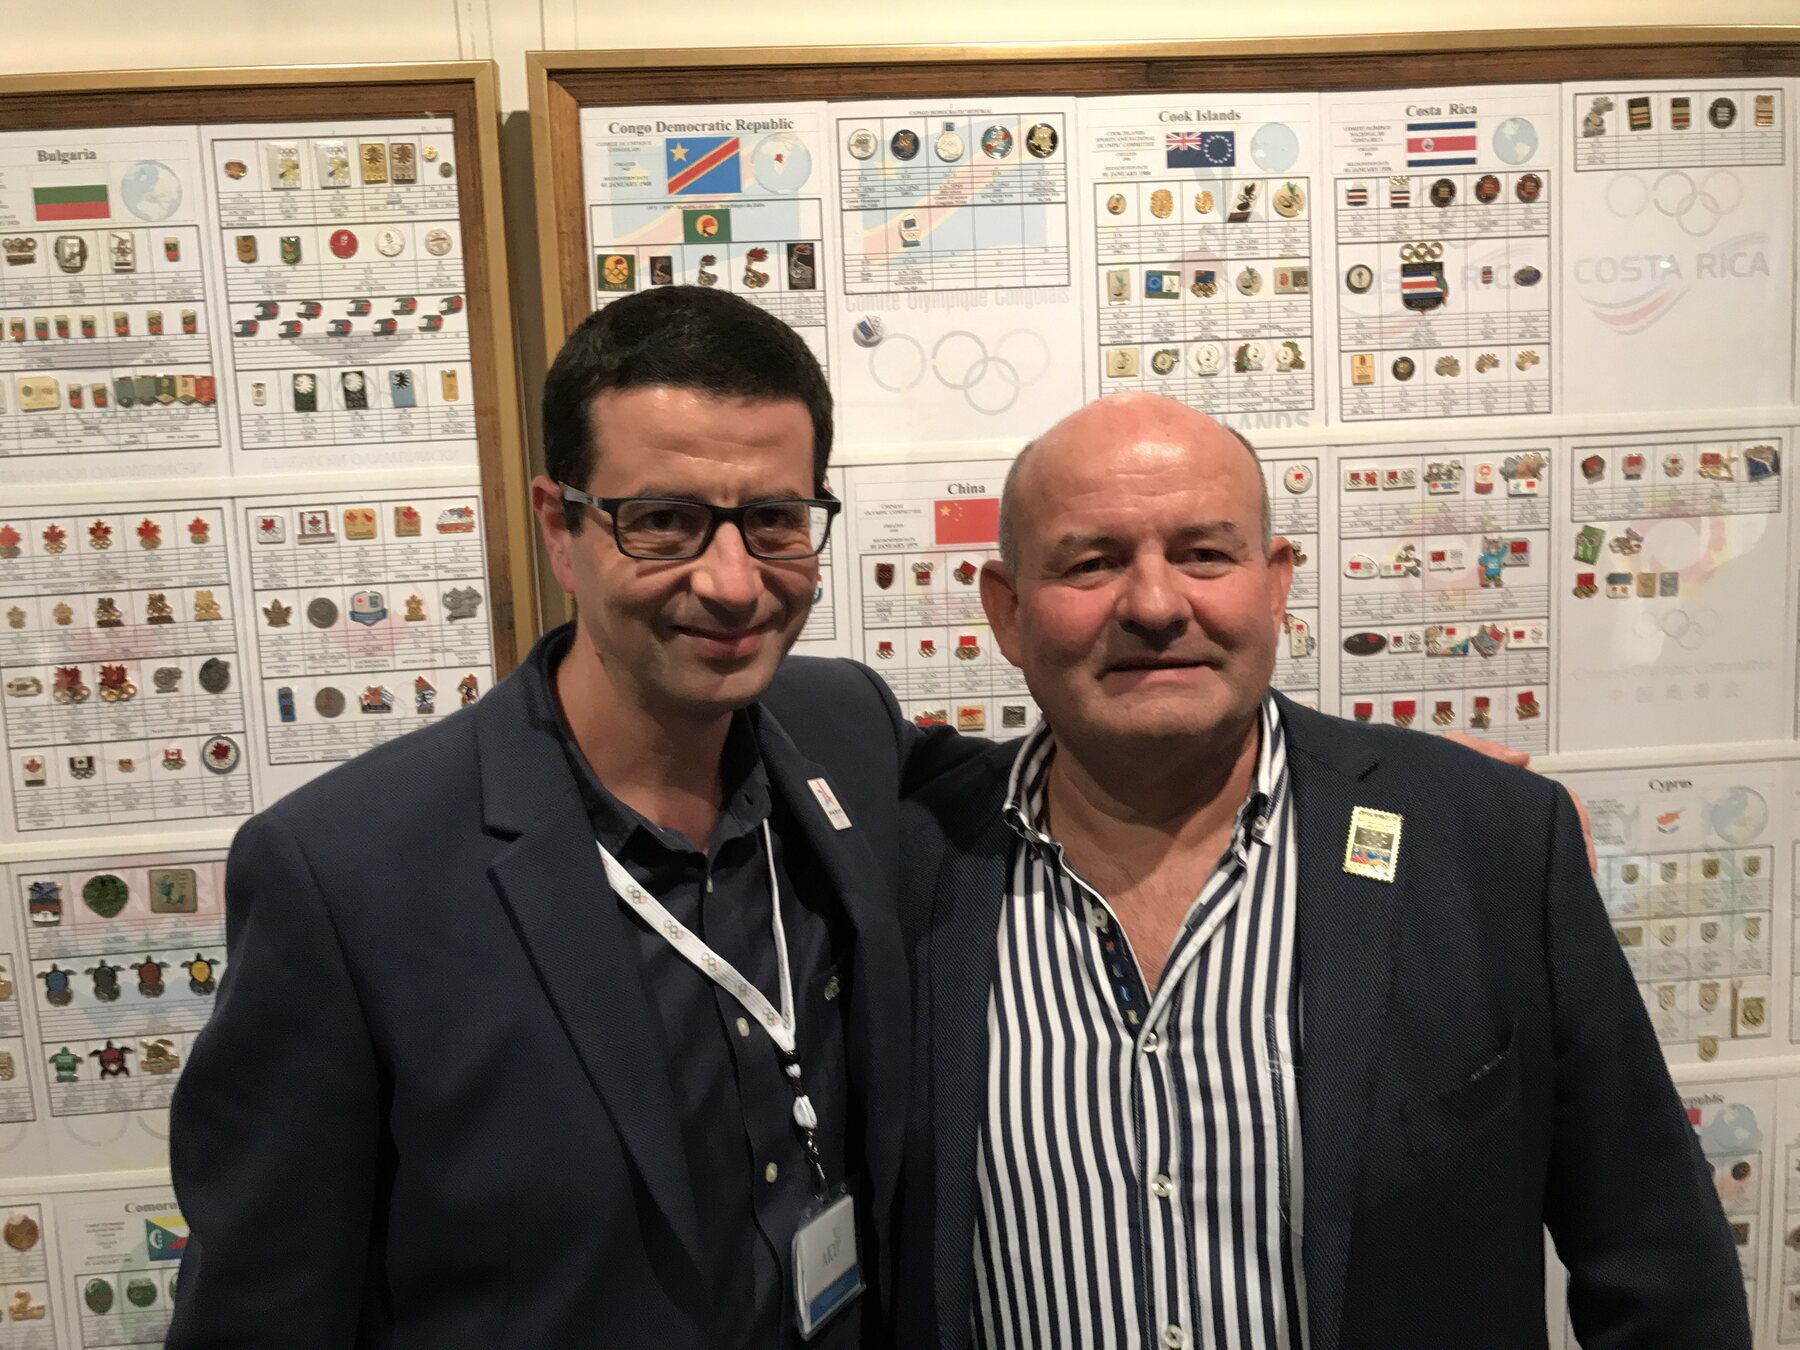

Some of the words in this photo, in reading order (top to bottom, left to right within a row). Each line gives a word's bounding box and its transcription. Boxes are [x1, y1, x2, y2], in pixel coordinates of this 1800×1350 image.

[1158, 109, 1193, 122] Cook
[1196, 109, 1242, 121] Islands
[1405, 104, 1442, 117] Costa
[1448, 103, 1478, 115] Rica
[608, 122, 652, 136] Congo
[656, 120, 732, 133] Democratic
[736, 118, 794, 134] Republic
[37, 149, 97, 164] Bulgaria
[1573, 255, 1684, 285] COSTA
[1695, 251, 1771, 279] RICA
[947, 483, 986, 495] China
[1648, 778, 1694, 793] Cyprus
[1681, 1091, 1725, 1107] epublic
[124, 1202, 178, 1213] Comoro
